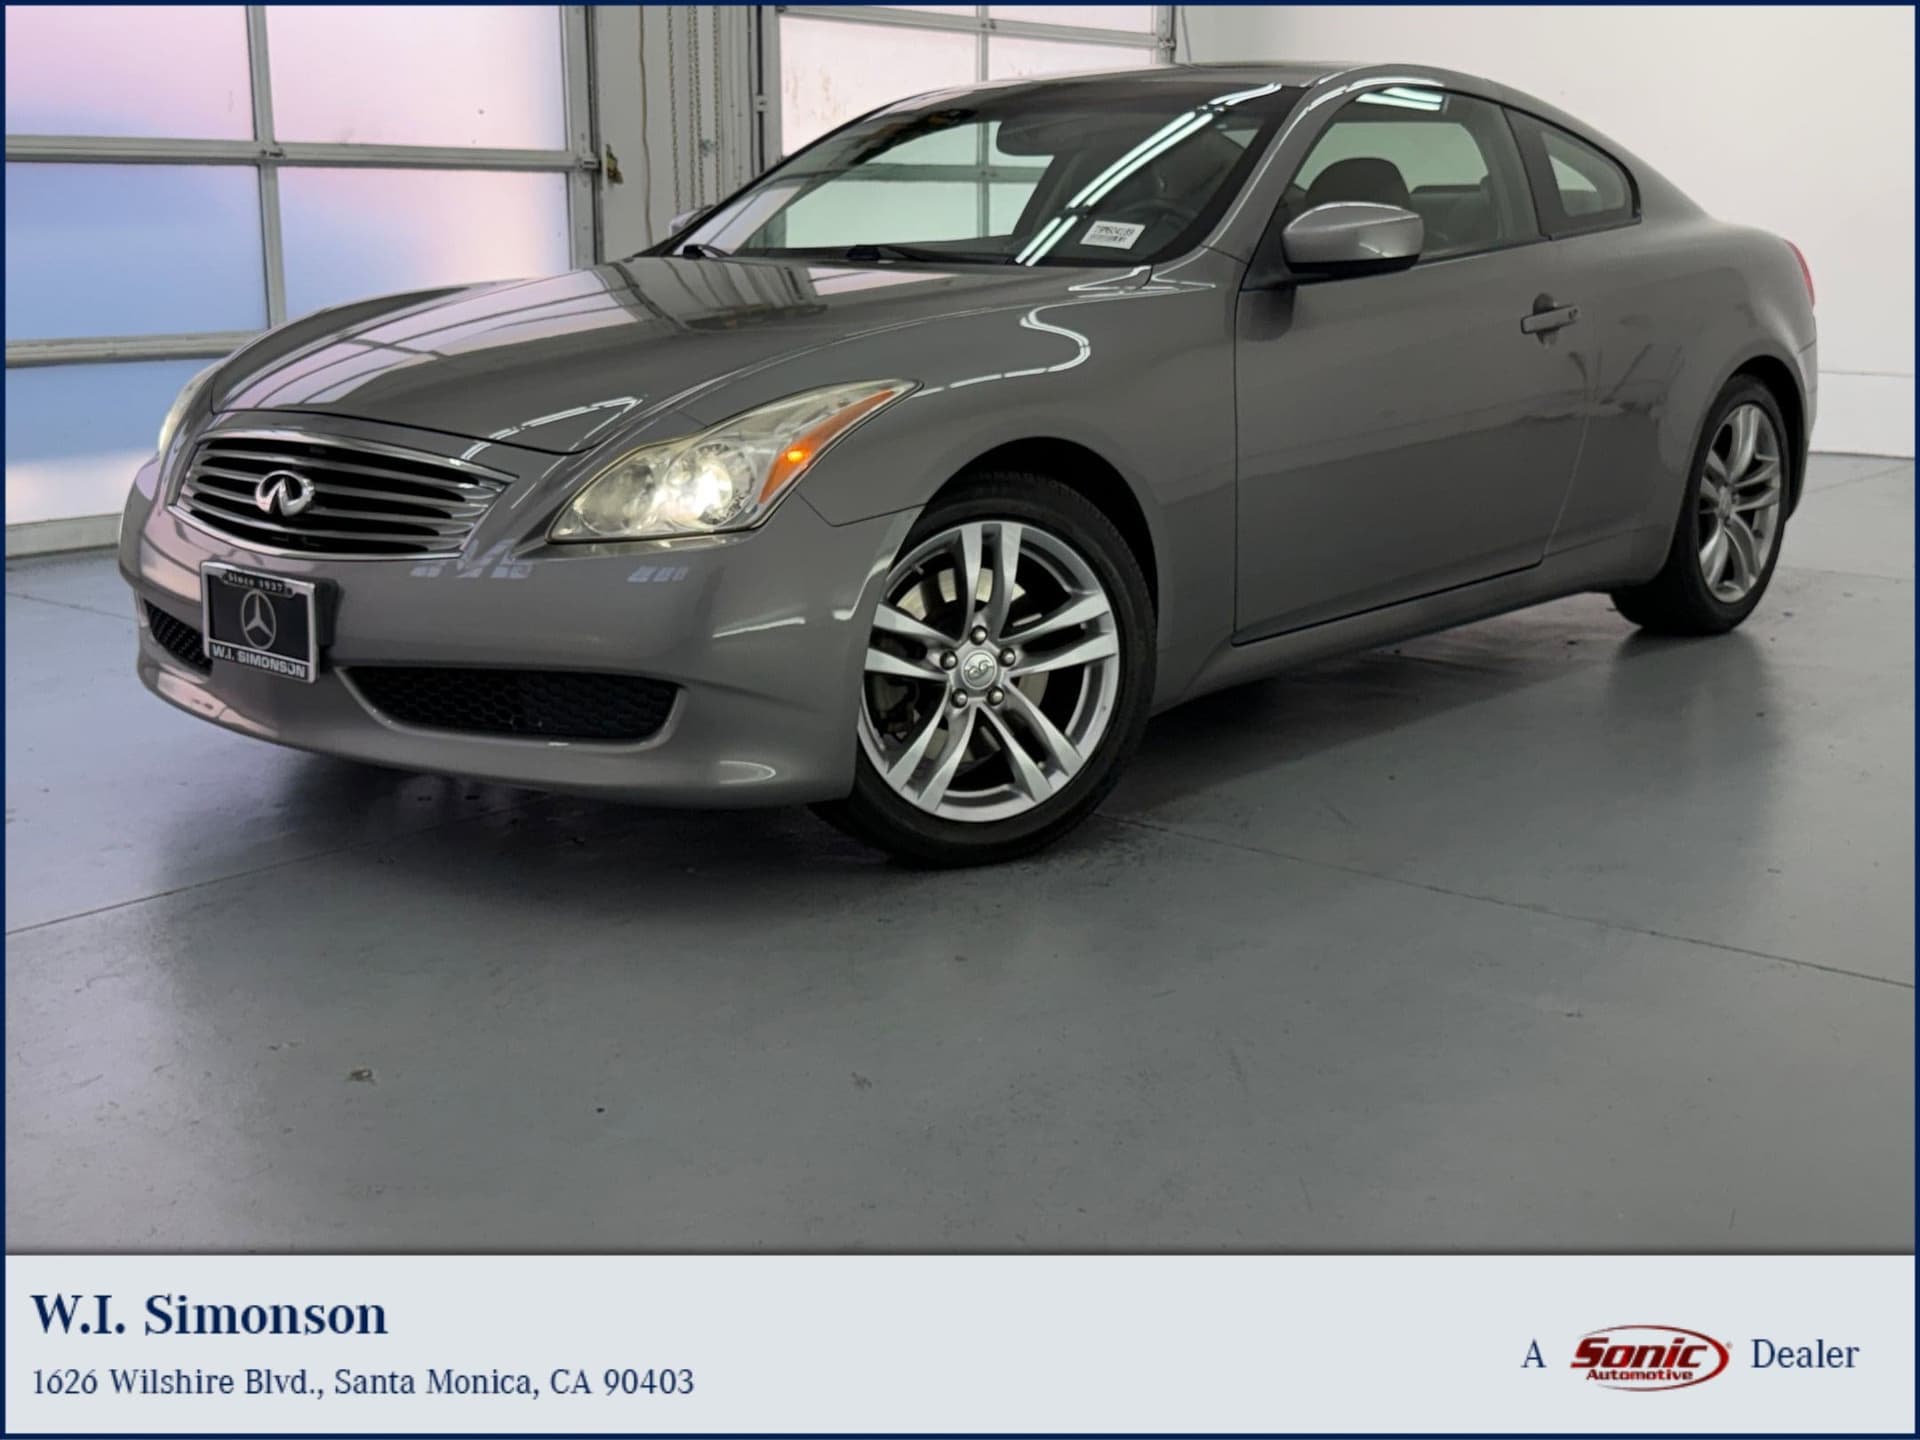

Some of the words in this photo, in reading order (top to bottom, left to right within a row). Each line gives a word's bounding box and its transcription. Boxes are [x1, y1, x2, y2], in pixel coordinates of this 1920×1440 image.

[228, 572, 255, 586] Since
[212, 644, 235, 660] W.I.
[237, 650, 305, 677] SIMONSON
